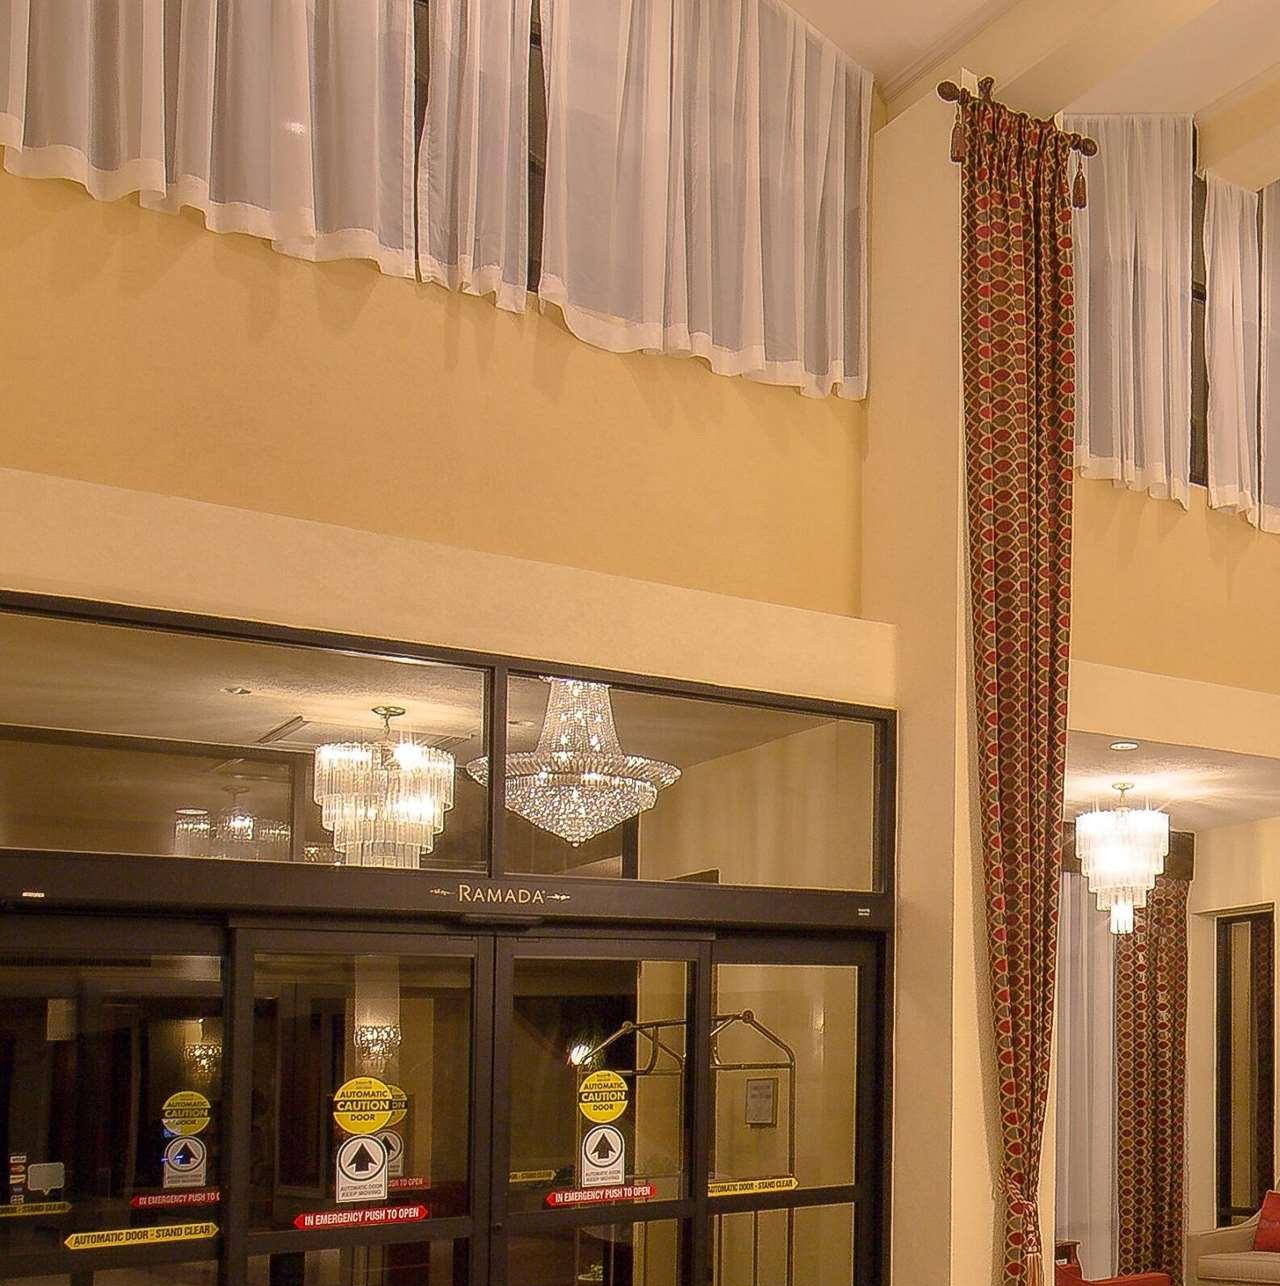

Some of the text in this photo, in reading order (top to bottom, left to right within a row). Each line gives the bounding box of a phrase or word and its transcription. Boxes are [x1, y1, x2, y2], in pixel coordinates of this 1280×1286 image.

[584, 1082, 624, 1090] AUTOMATIC
[340, 1090, 388, 1099] AUTOMATIC
[582, 1091, 625, 1101] CAUTION
[337, 1101, 389, 1111] CAUTION
[164, 1109, 208, 1118] CAUTION
[776, 1180, 792, 1188] CLEAR
[148, 1194, 186, 1204] EMERGENCY
[188, 1192, 206, 1202] PUSH
[207, 1192, 215, 1201] TO
[555, 1186, 650, 1203] IN EMERGENCY PUSH TO OPEN
[304, 1207, 419, 1226] IN EMERGENCY PUSH TO OPEN
[74, 1232, 124, 1245] AUTOMATIC
[125, 1230, 149, 1241] DOOR
[155, 1227, 182, 1238] STAND
[184, 1224, 210, 1235] CLEAR
